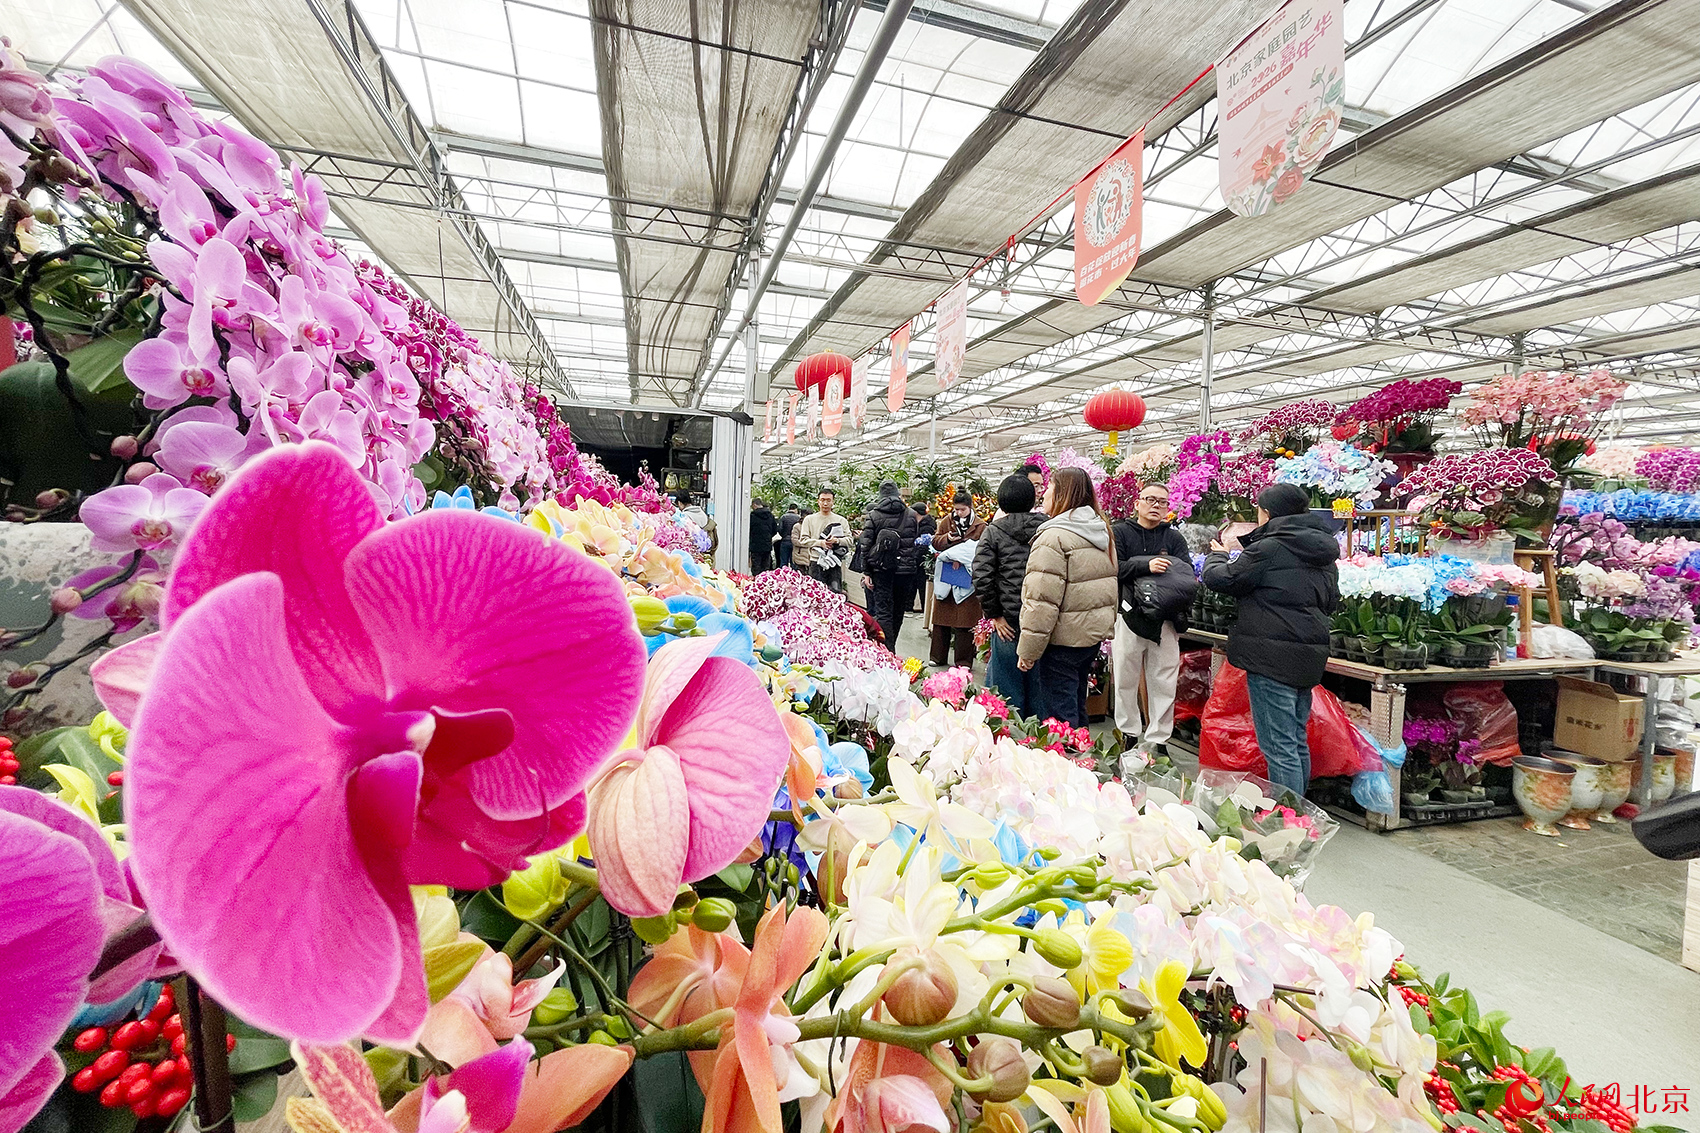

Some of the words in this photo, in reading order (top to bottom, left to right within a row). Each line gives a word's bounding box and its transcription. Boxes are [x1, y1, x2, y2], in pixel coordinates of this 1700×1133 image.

[1227, 8, 1312, 90] 北京家庭园艺
[1251, 60, 1277, 89] 2026
[1280, 10, 1333, 70] 嘉年华
